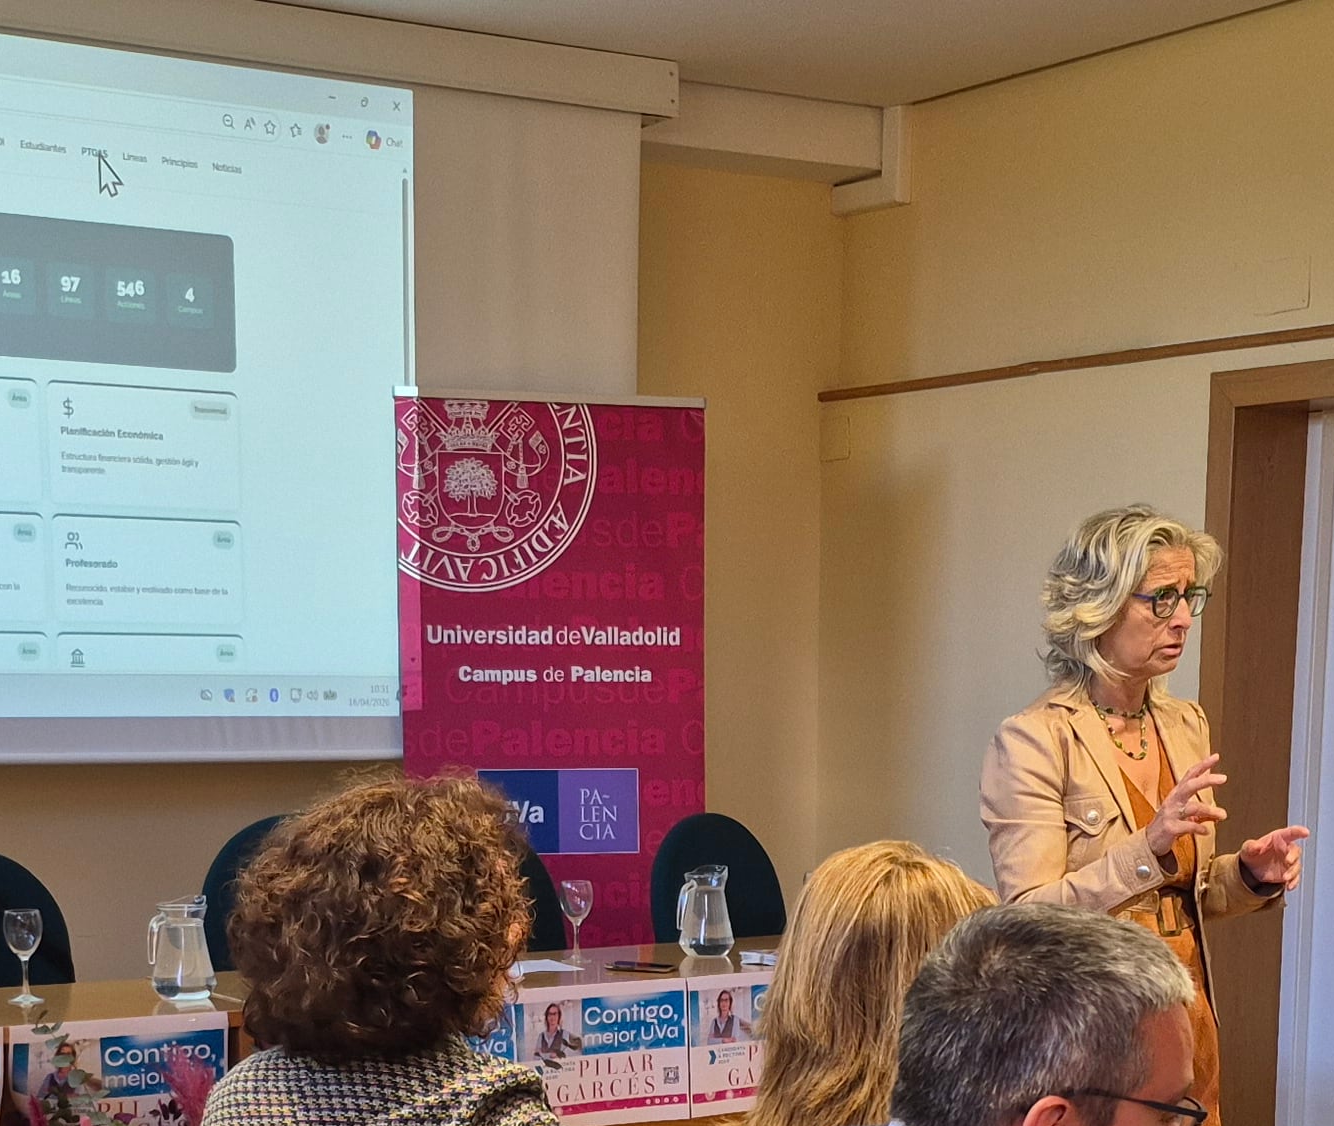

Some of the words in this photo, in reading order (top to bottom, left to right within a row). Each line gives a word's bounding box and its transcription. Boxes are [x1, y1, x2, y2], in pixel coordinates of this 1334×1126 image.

[385, 136, 403, 149] Chat
[20, 139, 67, 154] Estudiantes
[161, 156, 198, 169] Principios
[212, 162, 242, 174] Noticias
[1, 268, 22, 285] 16
[60, 276, 81, 293] 97
[116, 280, 145, 298] 546
[184, 287, 195, 303] 4
[65, 558, 119, 569] Profesorado
[426, 624, 554, 645] Universidad
[458, 665, 538, 685] Campus
[542, 665, 565, 683] de
[570, 665, 652, 683] Palencia
[580, 805, 617, 823] LEN
[579, 822, 616, 841] CIA
[584, 1001, 679, 1026] Contigo,
[584, 1027, 637, 1046] mejor
[641, 1023, 679, 1040] UVa
[579, 1053, 654, 1078] PILAR
[556, 1073, 655, 1104] GARCÉS
